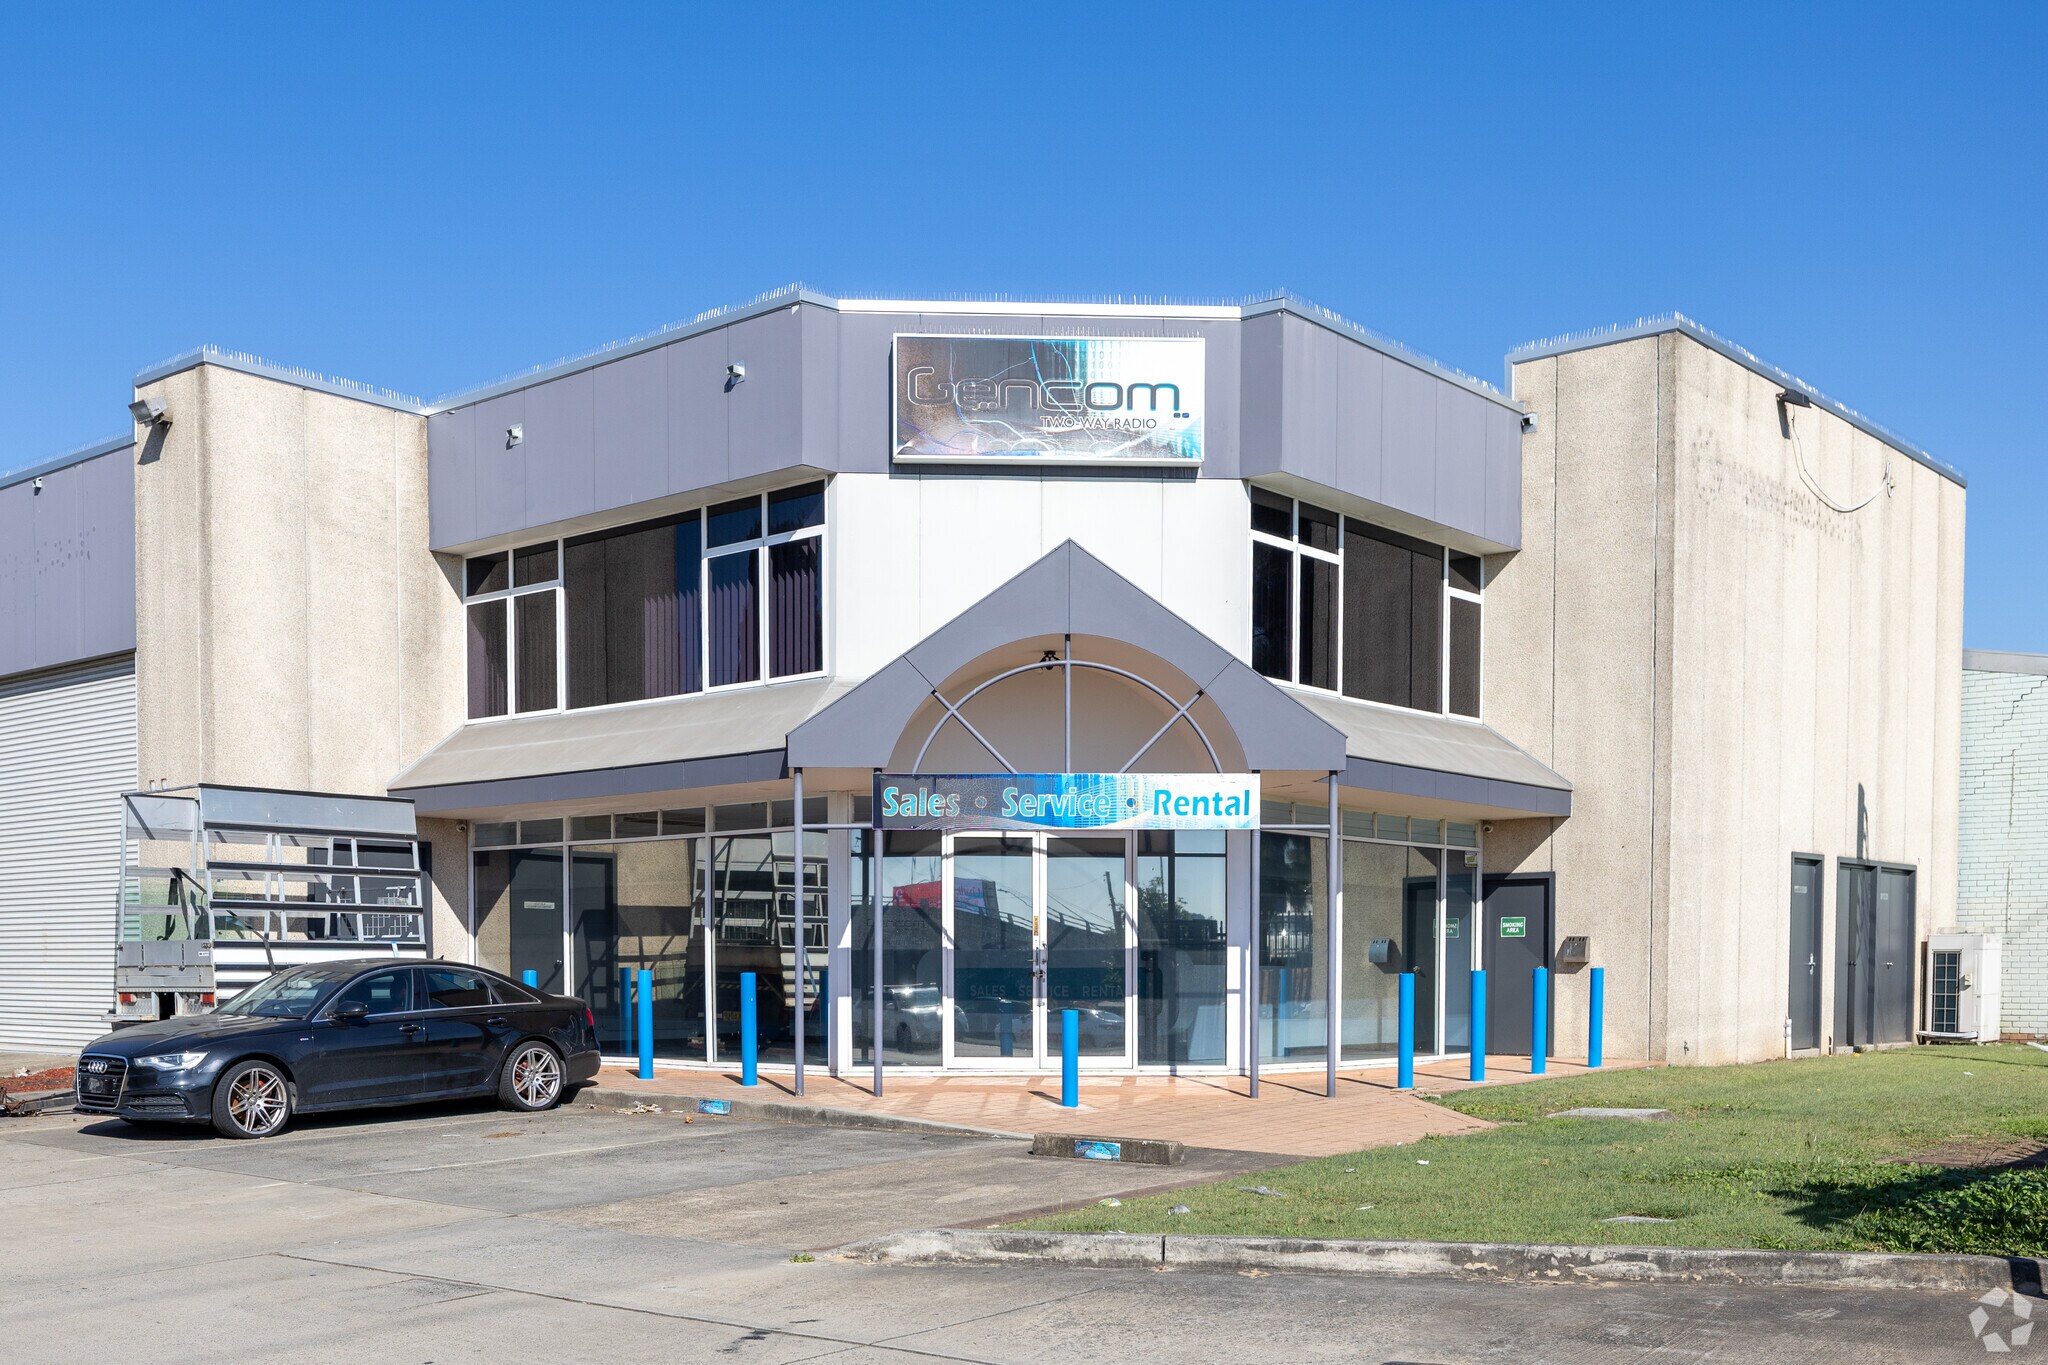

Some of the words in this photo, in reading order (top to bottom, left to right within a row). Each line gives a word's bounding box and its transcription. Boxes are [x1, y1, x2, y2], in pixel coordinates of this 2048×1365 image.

[1114, 417, 1157, 429] RADIO
[882, 787, 960, 817] Sales
[1001, 787, 1110, 817] Service
[1153, 789, 1250, 816] Rental
[970, 985, 1006, 997] SALES
[1018, 985, 1069, 998] SEICE
[1082, 985, 1125, 998] RENTA
